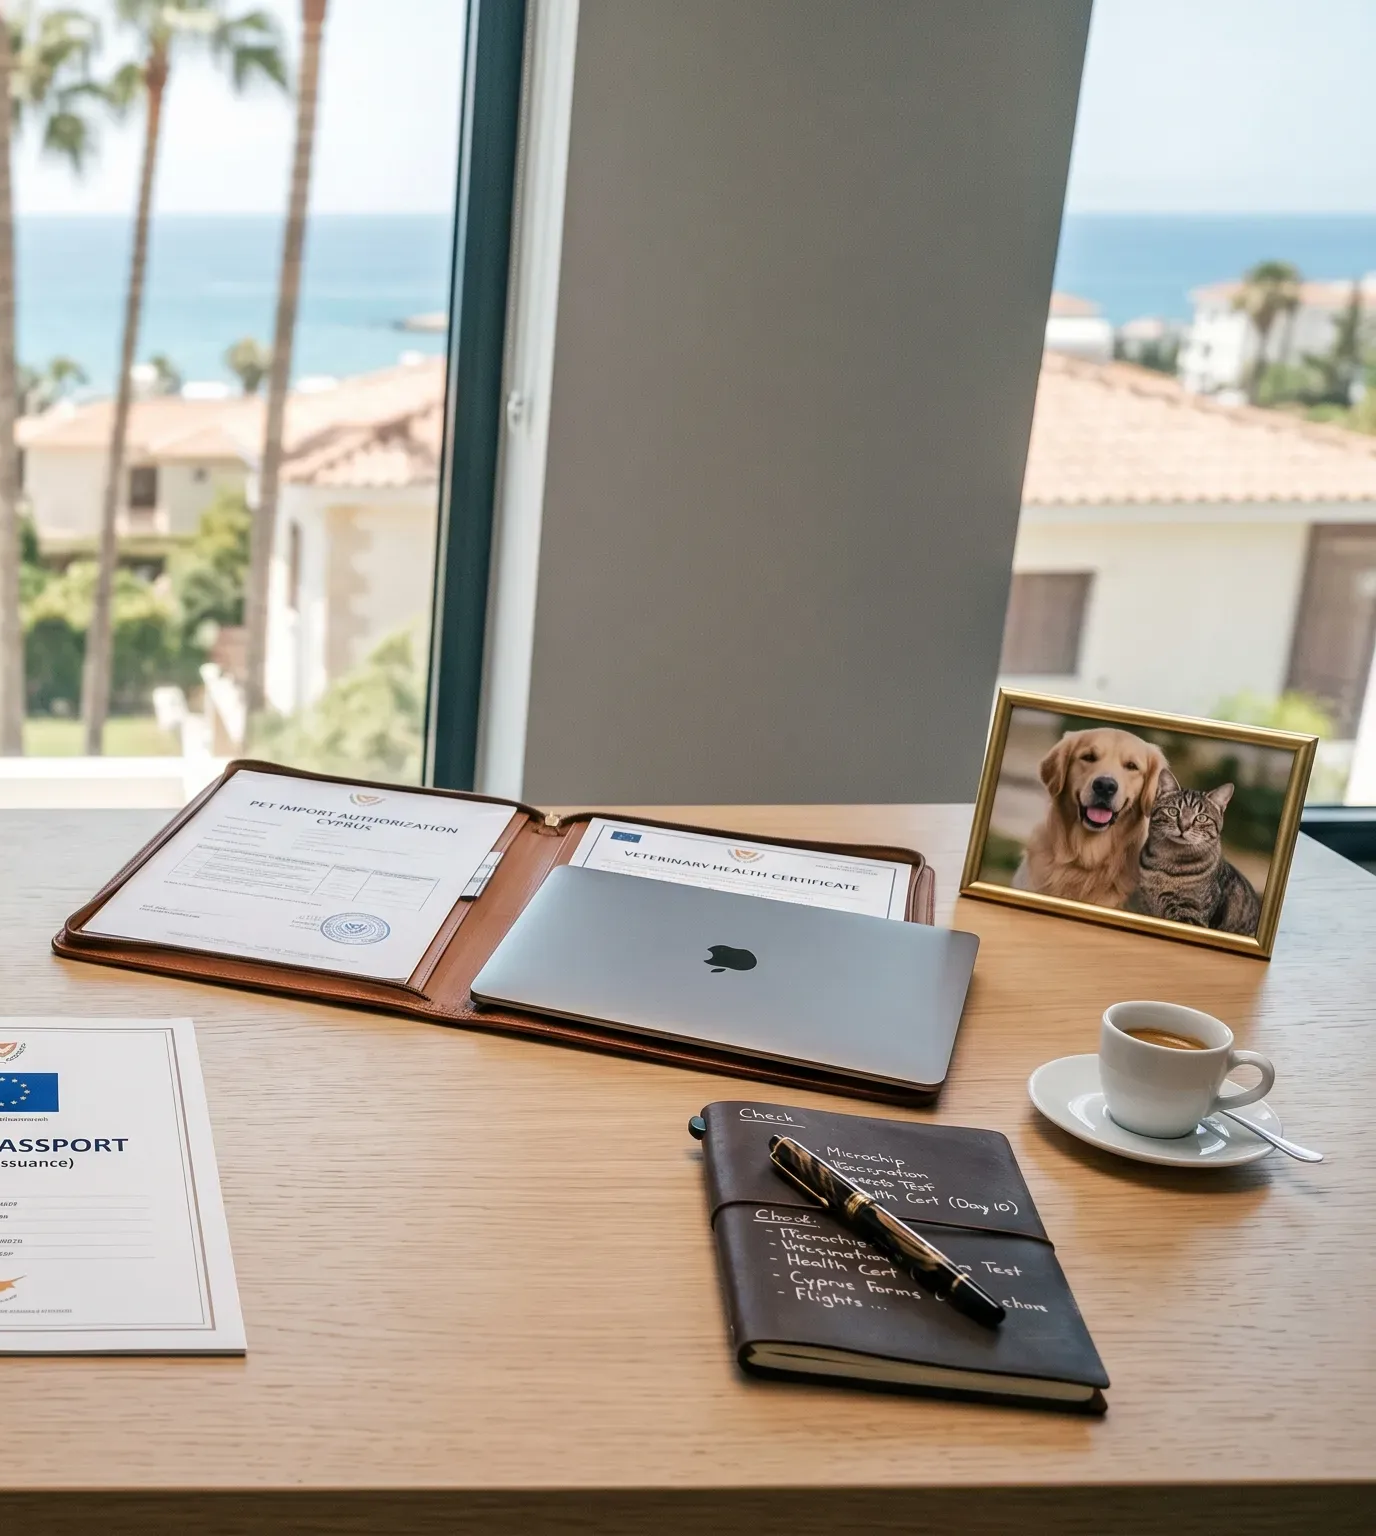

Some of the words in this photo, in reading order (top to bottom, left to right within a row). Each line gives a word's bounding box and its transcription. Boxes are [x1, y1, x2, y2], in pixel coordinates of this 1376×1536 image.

[249, 800, 276, 810] PET
[279, 803, 337, 818] IMPORT
[337, 812, 459, 834] AUTHORIZATION
[316, 818, 373, 831] CYPRUS
[624, 850, 710, 869] VETERINARY
[712, 865, 768, 878] HEALTH
[771, 874, 861, 891] CERTIFICATE
[739, 1108, 794, 1124] Check
[826, 1146, 905, 1169] Microchip
[948, 1196, 990, 1216] (Day
[993, 1199, 1019, 1216] 10)
[786, 1253, 848, 1272] Health
[858, 1264, 897, 1278] Cert
[981, 1261, 1023, 1277] Test
[790, 1270, 855, 1291] Cyprus
[866, 1280, 922, 1300] Forms
[795, 1287, 863, 1308] Flights
